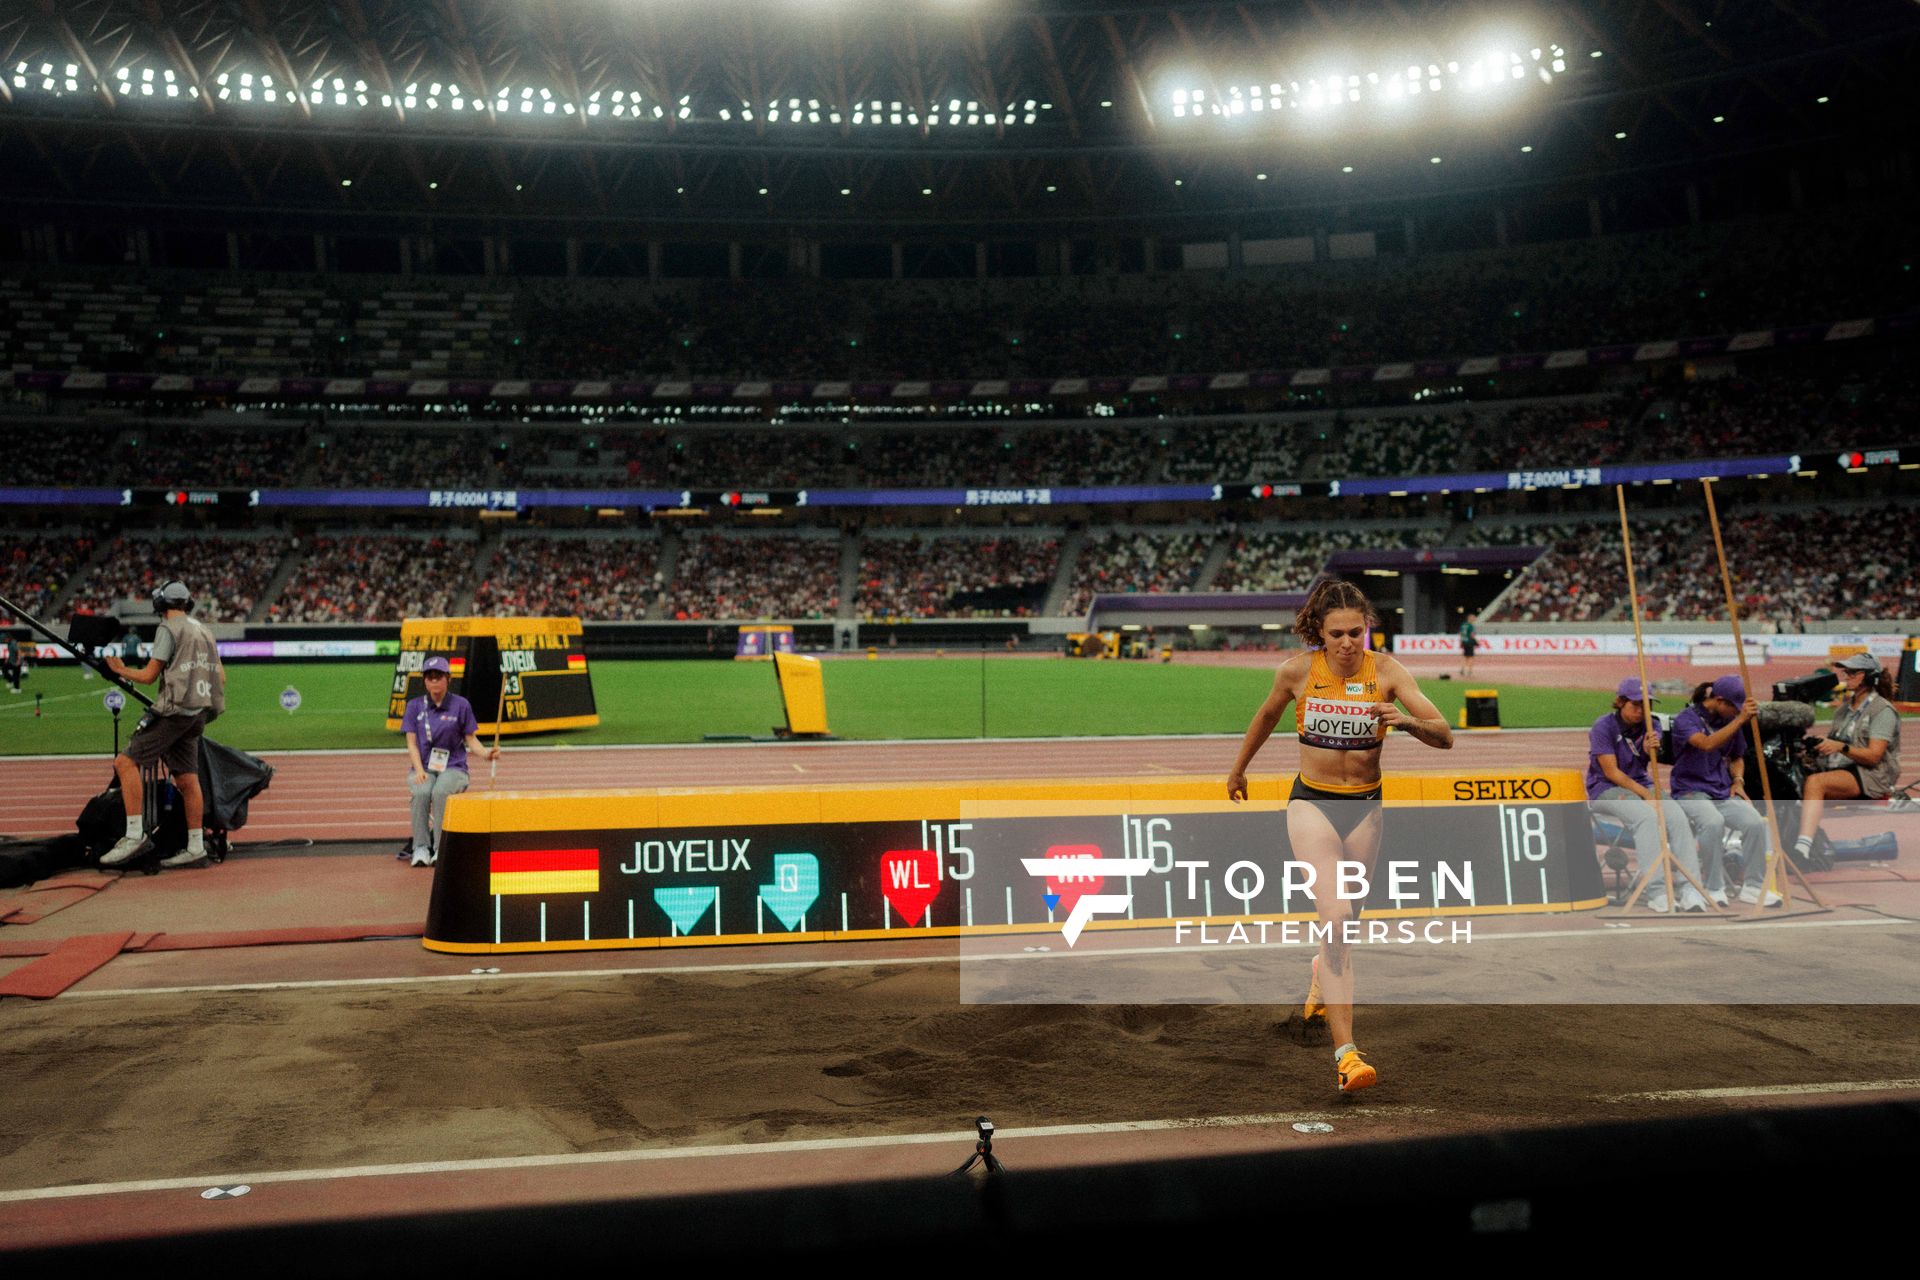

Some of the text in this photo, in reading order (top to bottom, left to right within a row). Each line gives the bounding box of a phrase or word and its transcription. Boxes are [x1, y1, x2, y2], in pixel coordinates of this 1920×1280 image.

[1400, 638, 1484, 650] HONA
[1503, 638, 1598, 650] HONDA
[500, 651, 537, 673] JOYEUX
[1307, 718, 1374, 736] JOYEUX
[1453, 779, 1551, 801] SEIKO
[1130, 817, 1174, 875] 16
[1504, 807, 1549, 863] 18
[619, 838, 752, 875] JOYEUX
[930, 822, 975, 881] 15
[780, 863, 798, 893] Q
[889, 859, 931, 890] WL
